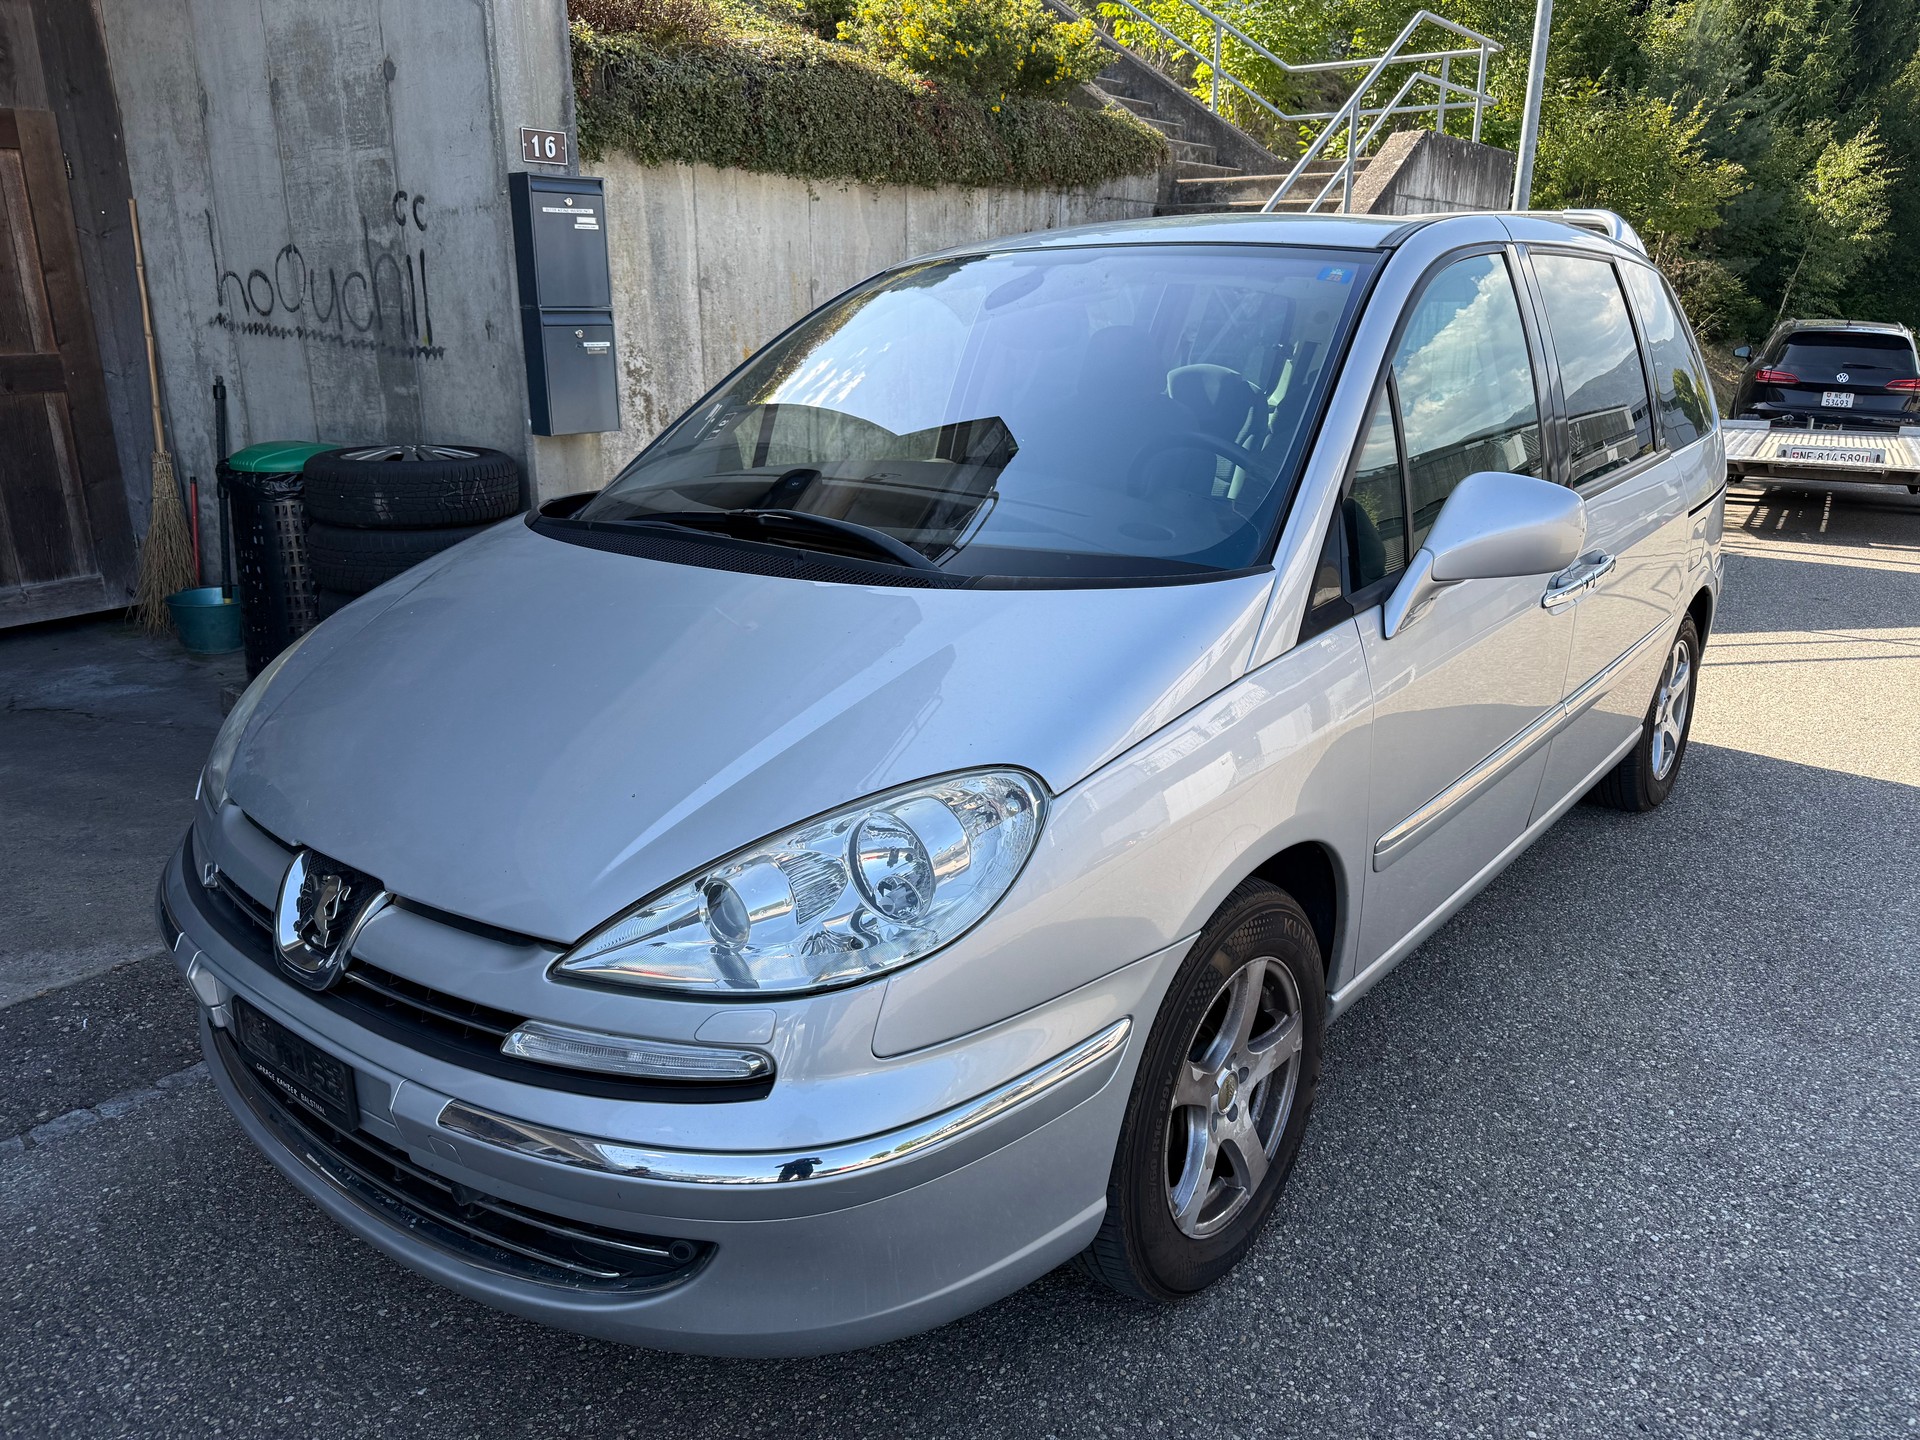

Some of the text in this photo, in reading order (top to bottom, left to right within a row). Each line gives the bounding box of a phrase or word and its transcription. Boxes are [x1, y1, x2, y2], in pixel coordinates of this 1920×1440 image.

[531, 134, 556, 158] 16
[1825, 398, 1849, 407] 53493
[1283, 917, 1320, 971] KUMHO
[1160, 1070, 1174, 1112] 99V
